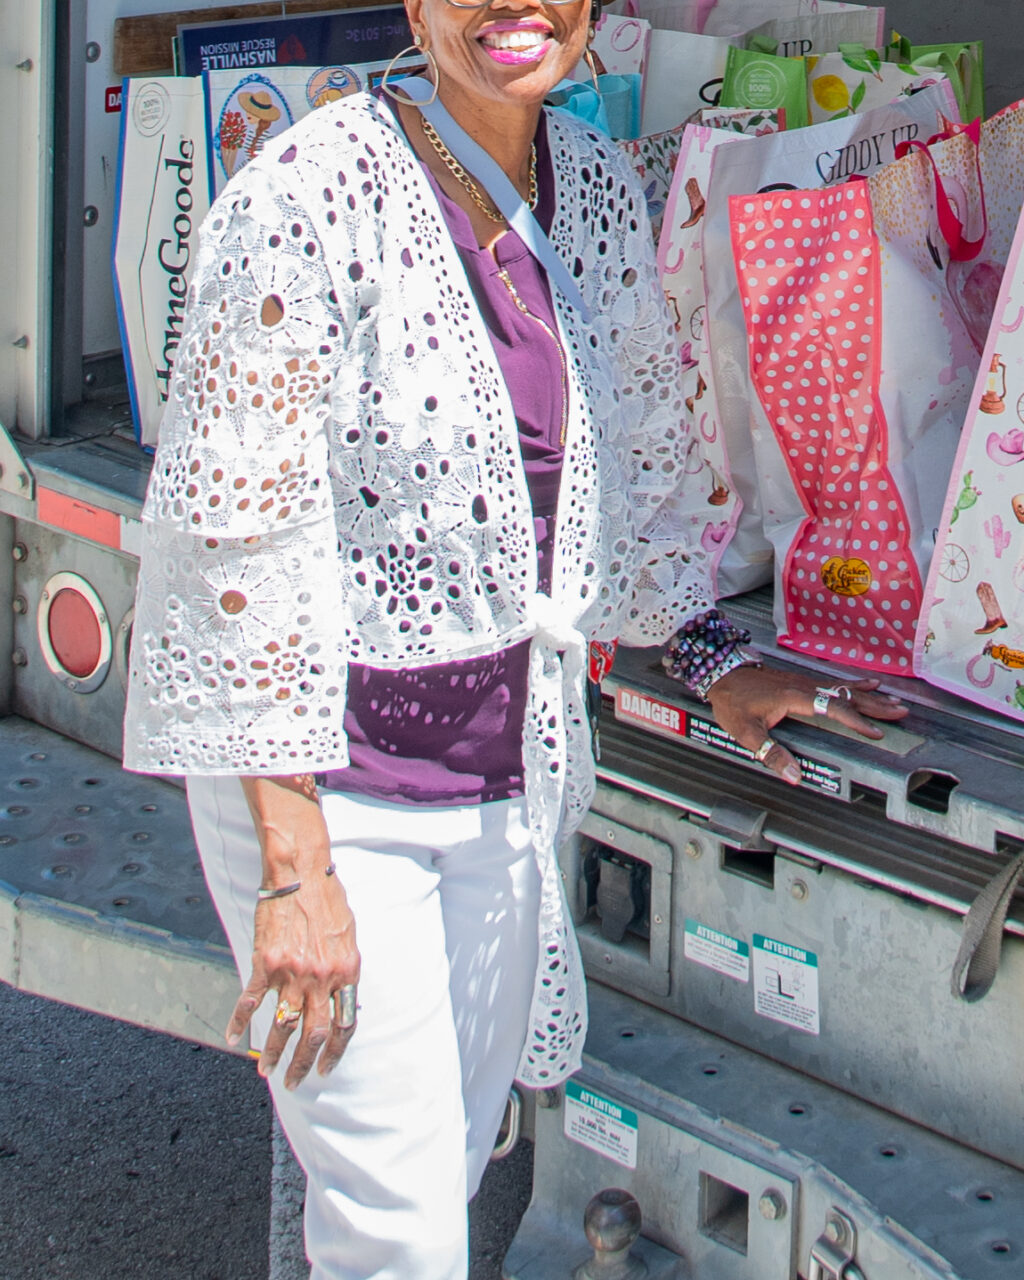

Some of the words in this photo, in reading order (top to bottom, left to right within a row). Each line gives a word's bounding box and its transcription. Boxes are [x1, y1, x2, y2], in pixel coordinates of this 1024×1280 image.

[201, 42, 239, 56] MISSION
[242, 38, 275, 50] RESCUE
[202, 50, 276, 70] NASHVILLE
[749, 84, 771, 92] 100%
[816, 133, 886, 184] GIDDY
[891, 123, 918, 154] UP
[621, 692, 679, 731] DANGER
[699, 720, 709, 731] NOT
[697, 925, 738, 951] ATTENTION
[763, 938, 806, 962] ATTENTION
[580, 1090, 622, 1120] ATTENTION
